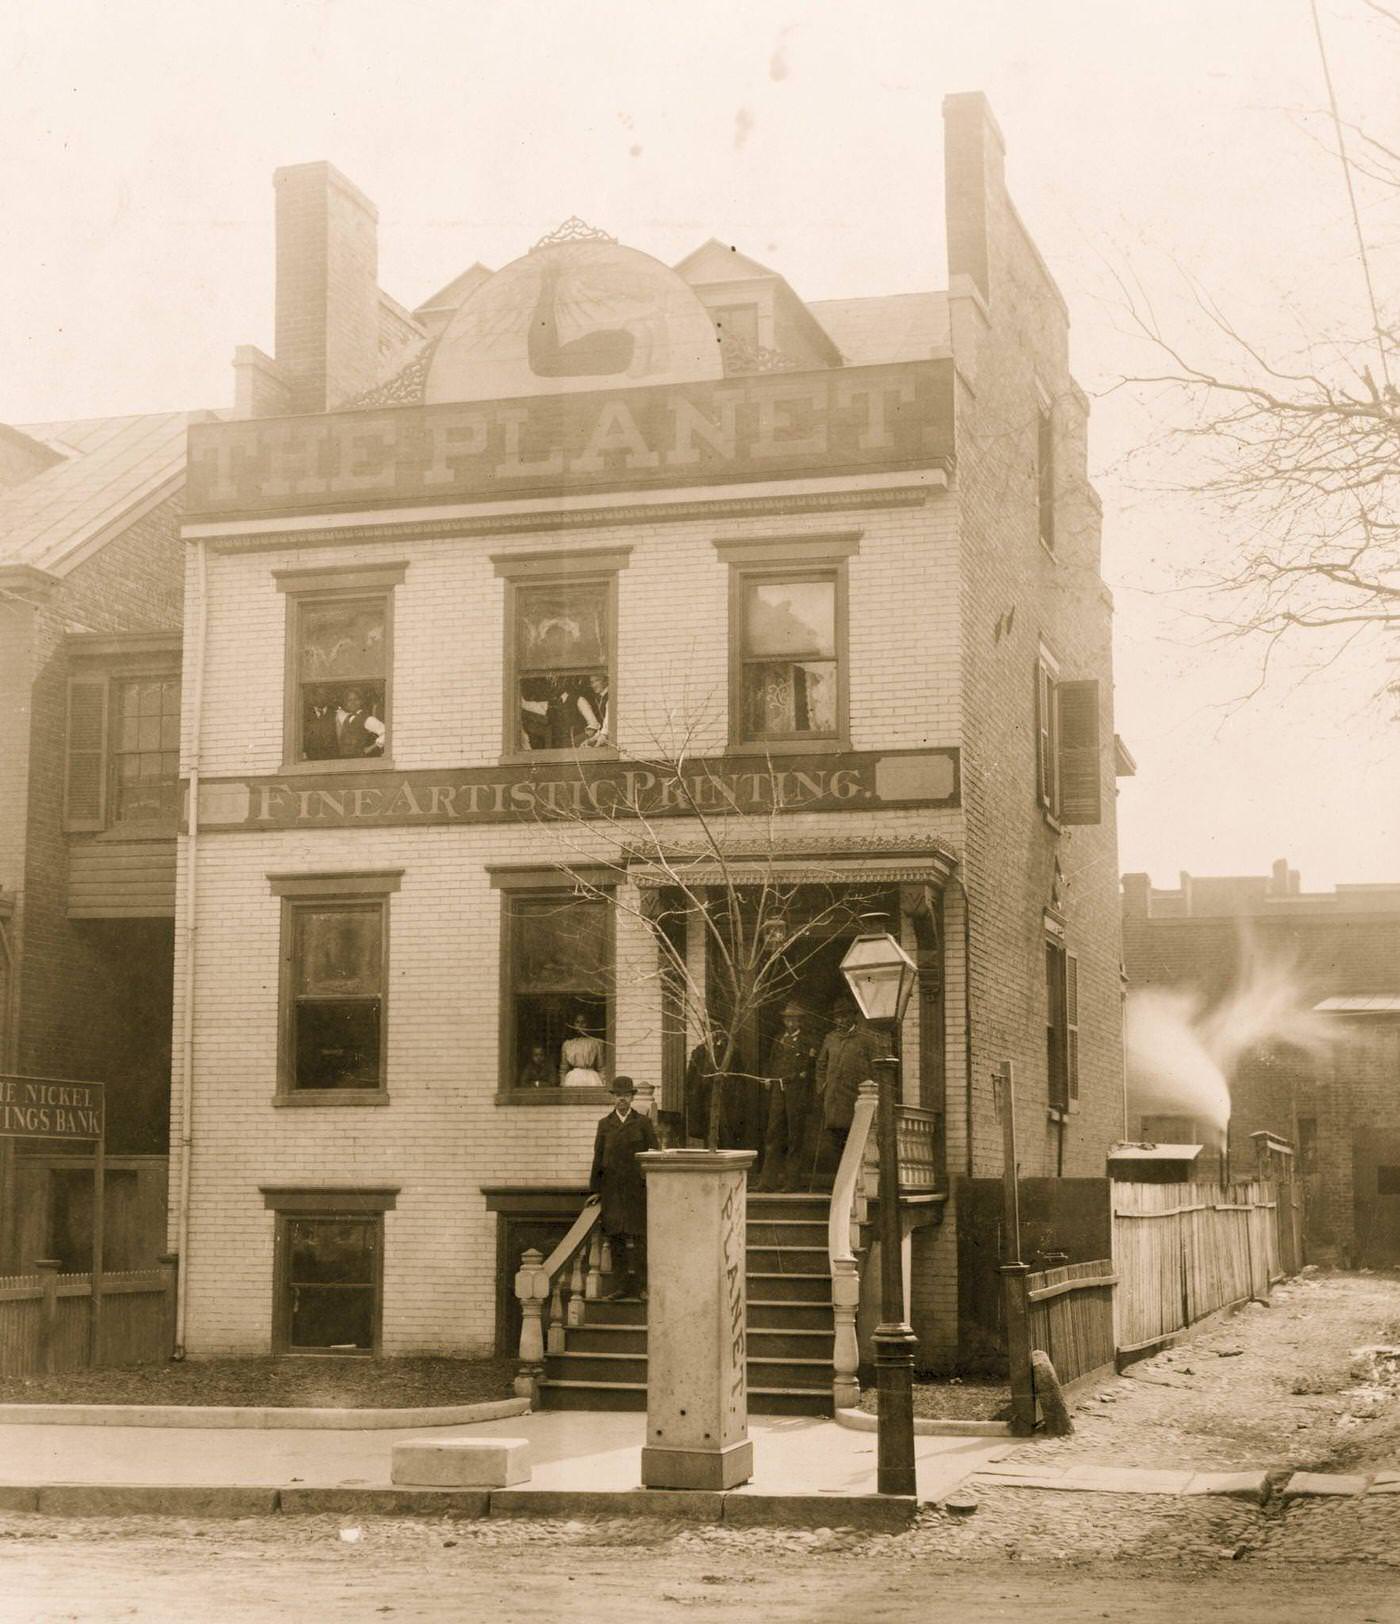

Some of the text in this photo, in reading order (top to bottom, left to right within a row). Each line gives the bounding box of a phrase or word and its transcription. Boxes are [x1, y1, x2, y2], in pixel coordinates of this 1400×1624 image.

[192, 422, 398, 500] THE
[255, 769, 873, 820] FINE ARTISTIC PRINTING.
[0, 1106, 100, 1134] INGS BANK
[25, 1084, 93, 1107] NICKEL
[721, 1186, 744, 1397] PLANET
